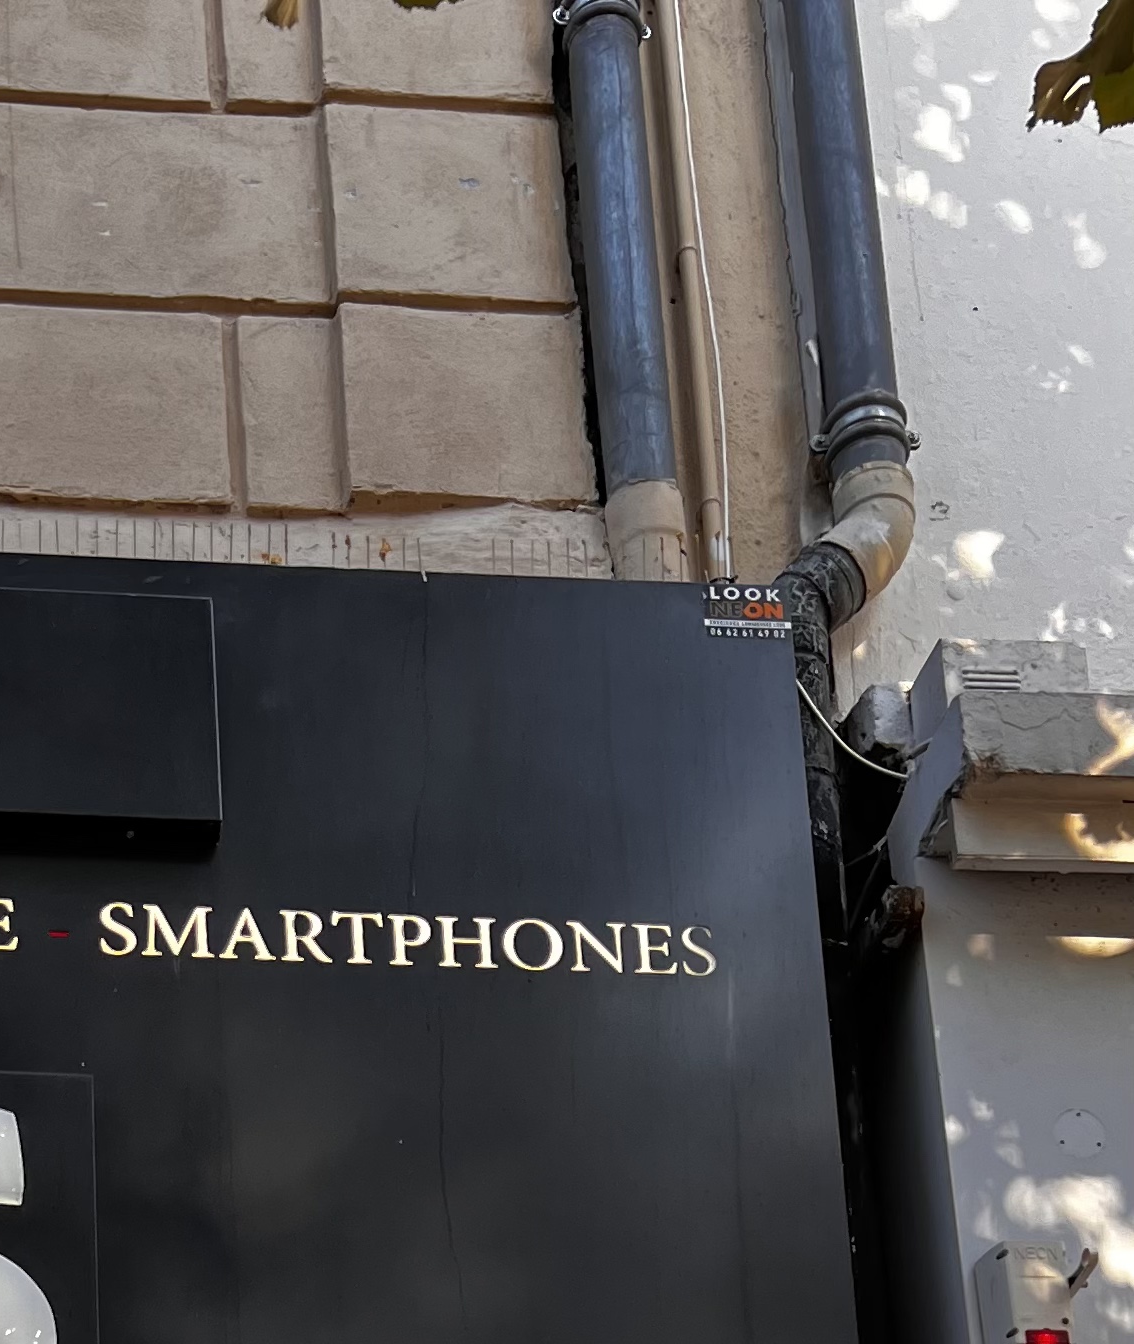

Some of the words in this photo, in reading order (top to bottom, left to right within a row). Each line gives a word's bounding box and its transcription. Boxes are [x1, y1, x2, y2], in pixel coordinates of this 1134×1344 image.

[709, 586, 781, 602] LOOK
[709, 600, 784, 619] NEON
[98, 901, 719, 977] SMARTPHONES
[1013, 1246, 1058, 1261] NEON
